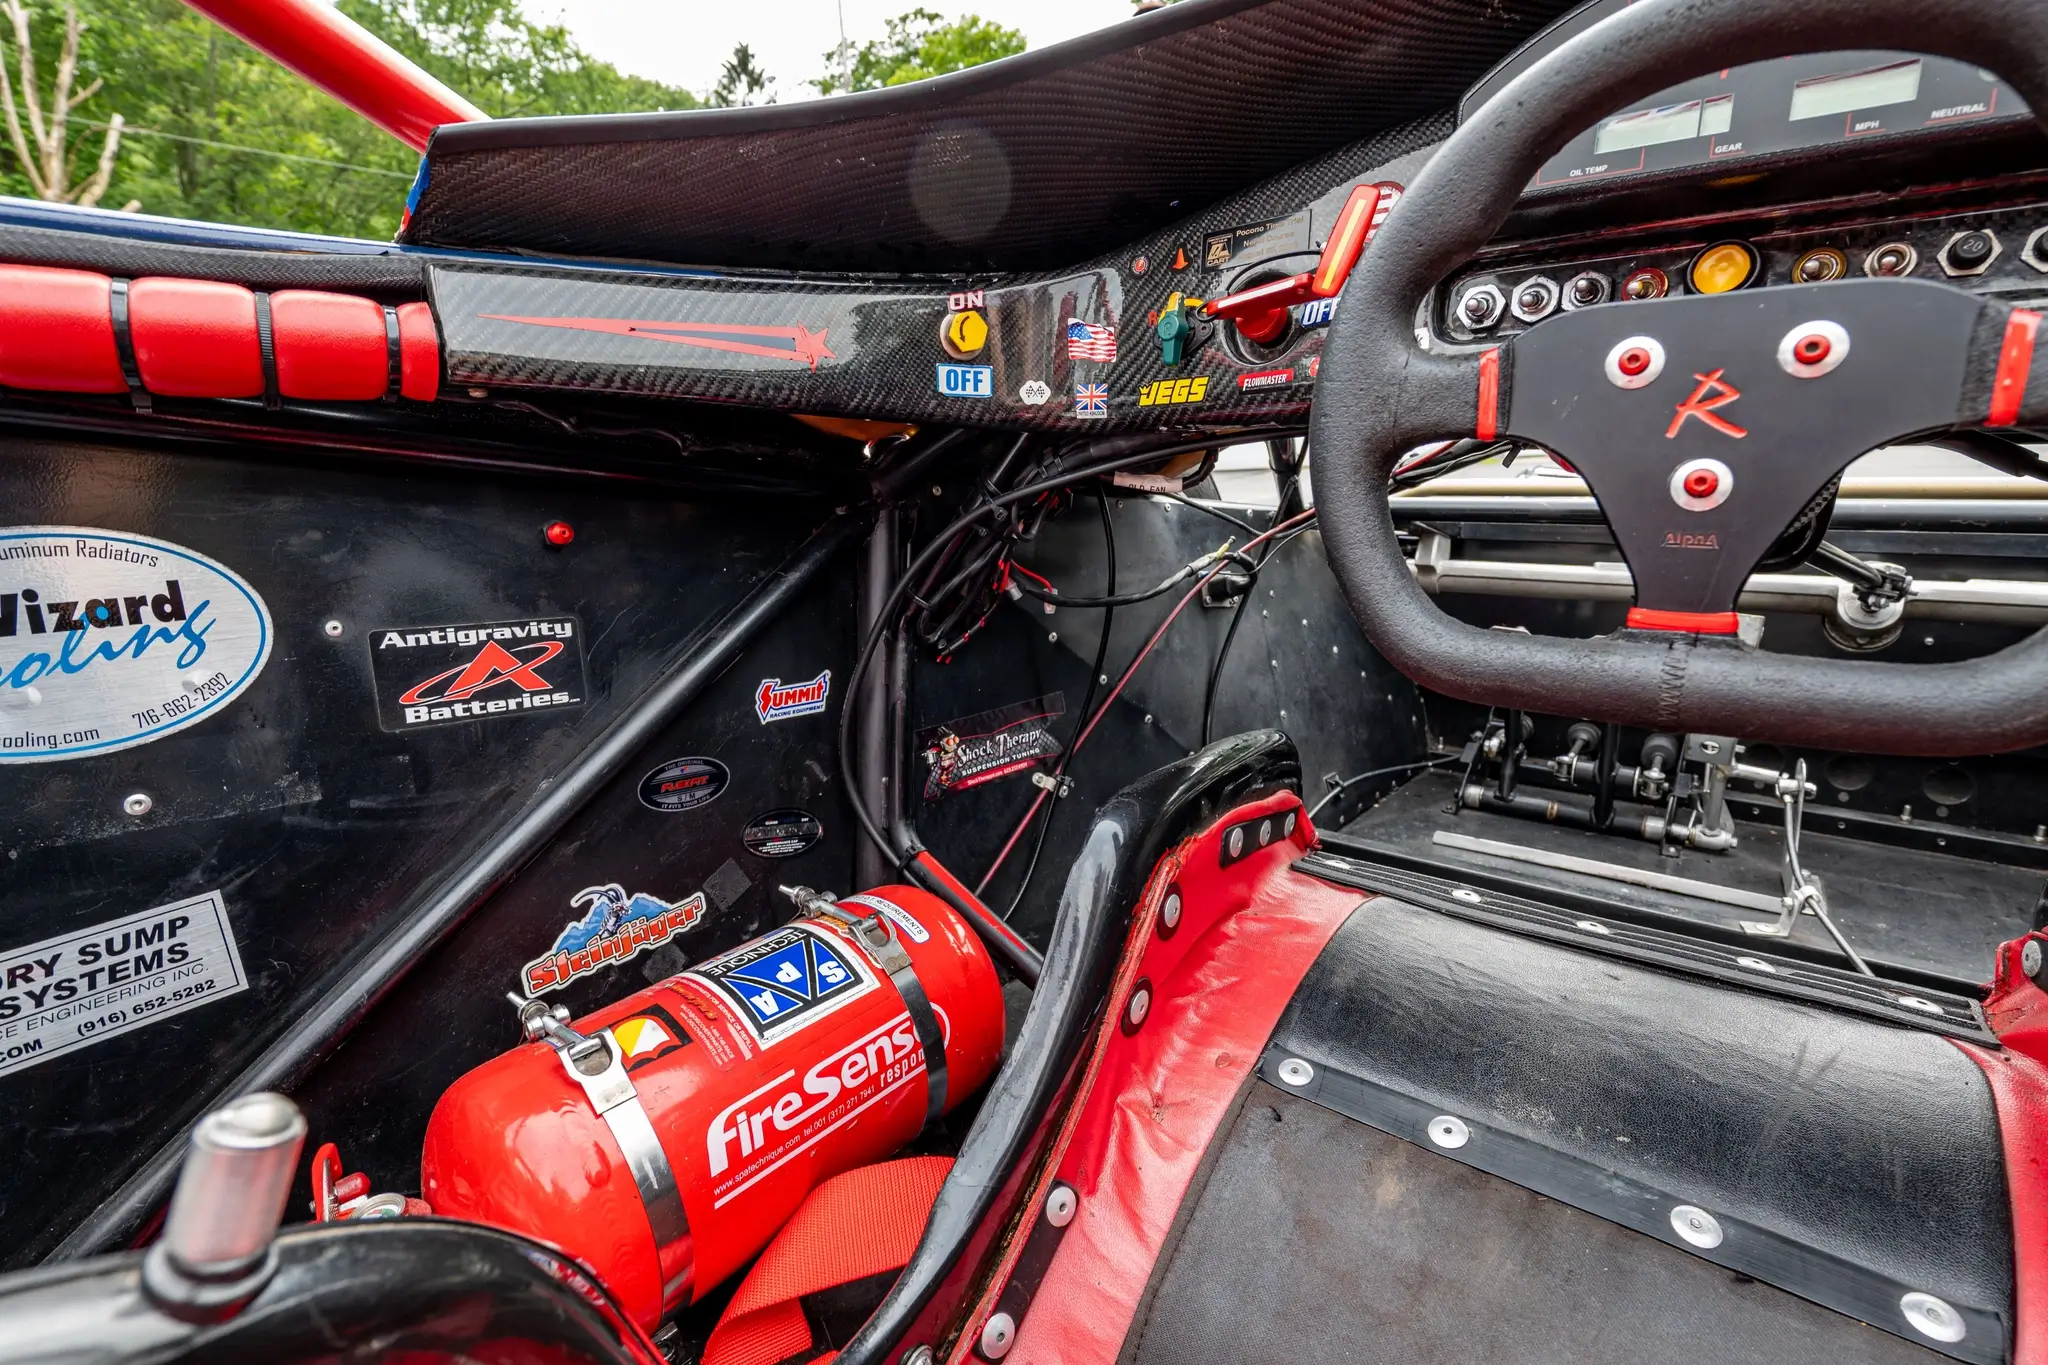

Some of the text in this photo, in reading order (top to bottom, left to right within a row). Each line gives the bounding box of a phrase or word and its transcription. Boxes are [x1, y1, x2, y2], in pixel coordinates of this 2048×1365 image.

[1931, 102, 1987, 119] NEUTRAL
[1855, 120, 1880, 131] MPH
[1714, 142, 1743, 154] GEAR
[1570, 164, 1608, 177] OIL TEMP
[1236, 226, 1265, 237] Pocono
[1962, 239, 1983, 251] 20
[949, 290, 984, 311] ON
[1303, 297, 1341, 326] OFF
[945, 368, 984, 393] OFF
[1139, 376, 1210, 407] JEGS
[1242, 373, 1288, 392] FLOWMASTER
[76, 539, 159, 568] Radiators
[379, 621, 573, 650] Antigravity
[132, 671, 233, 729] 716-662-2392
[404, 691, 570, 724] Batteries
[769, 705, 824, 719] RACING EQUIPMENT
[0, 729, 100, 749] ooling.com
[957, 729, 1041, 768] Shock Therapy
[962, 747, 1040, 776] SUSPENSION TUNING
[0, 915, 190, 990] RY SUMP
[528, 897, 702, 992] Steinjäger
[706, 931, 808, 976] TECHNIQUE
[0, 942, 190, 1020] SYSTEMS
[27, 976, 166, 1032] ENGINEERING
[173, 963, 209, 982] INC.
[77, 1010, 127, 1037] (916)
[132, 978, 216, 1015] 652-5282
[707, 1018, 921, 1178] FireSens
[713, 1085, 875, 1196] www.spatechnique.com tel.001 (317) 271 7941
